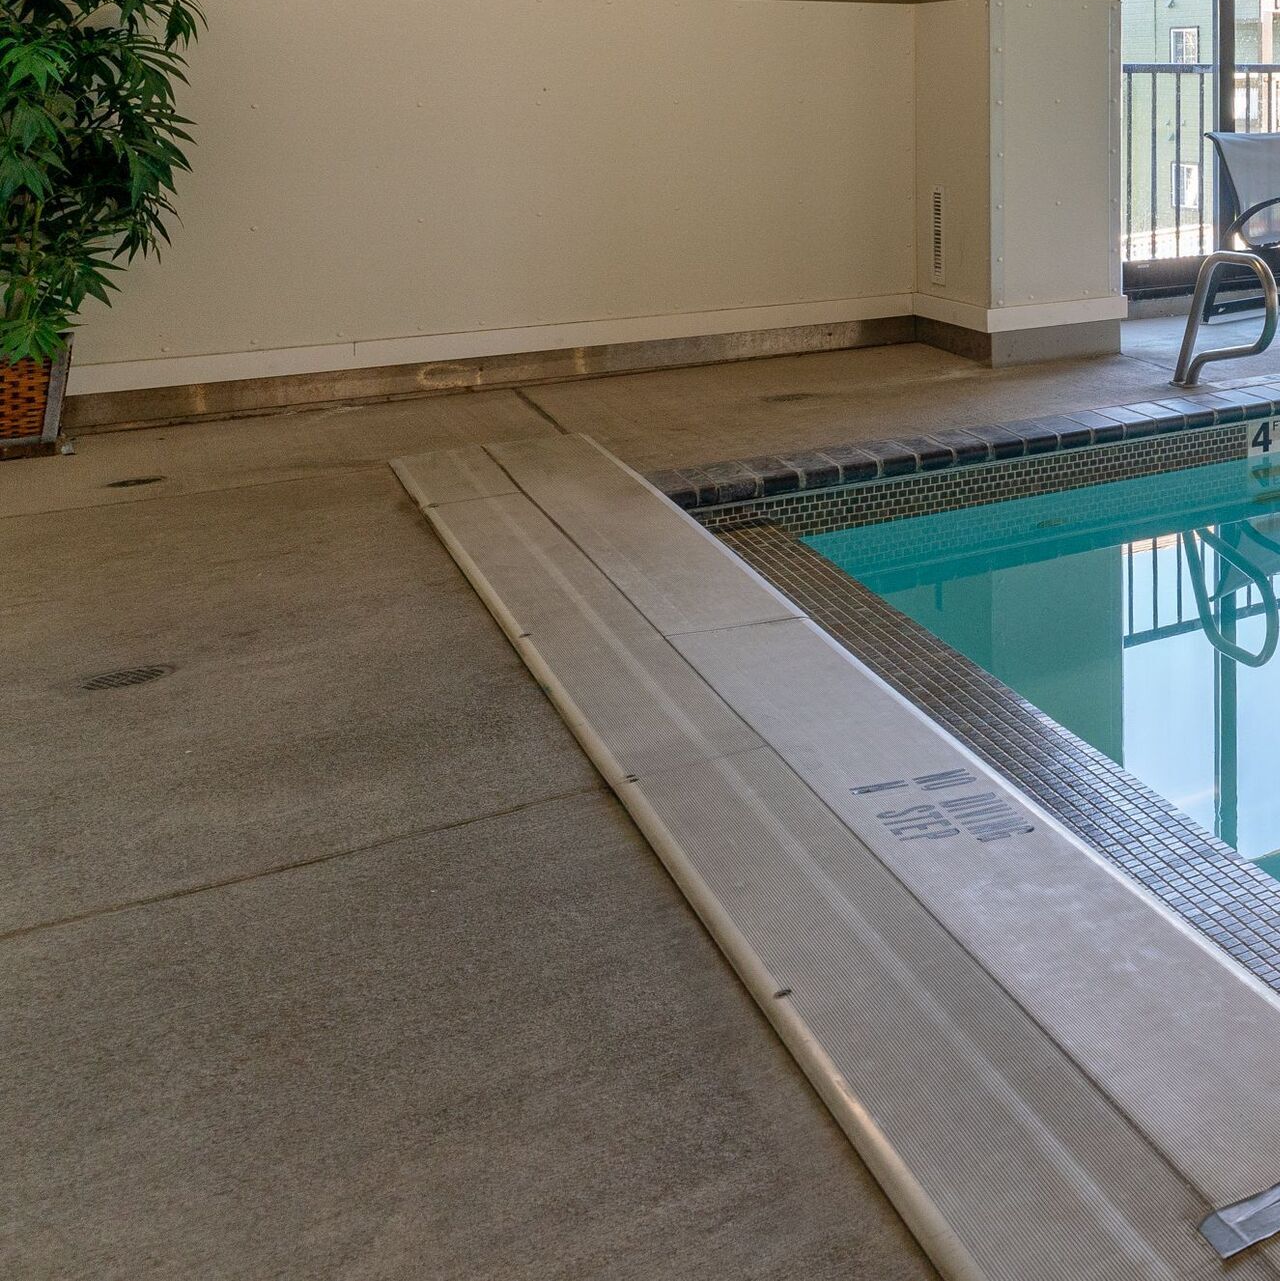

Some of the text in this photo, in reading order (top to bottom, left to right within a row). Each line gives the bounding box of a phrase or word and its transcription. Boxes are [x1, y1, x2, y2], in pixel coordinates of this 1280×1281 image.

[1251, 421, 1272, 452] 4
[876, 804, 960, 842] STEP
[911, 768, 1035, 842] NO DIVING
